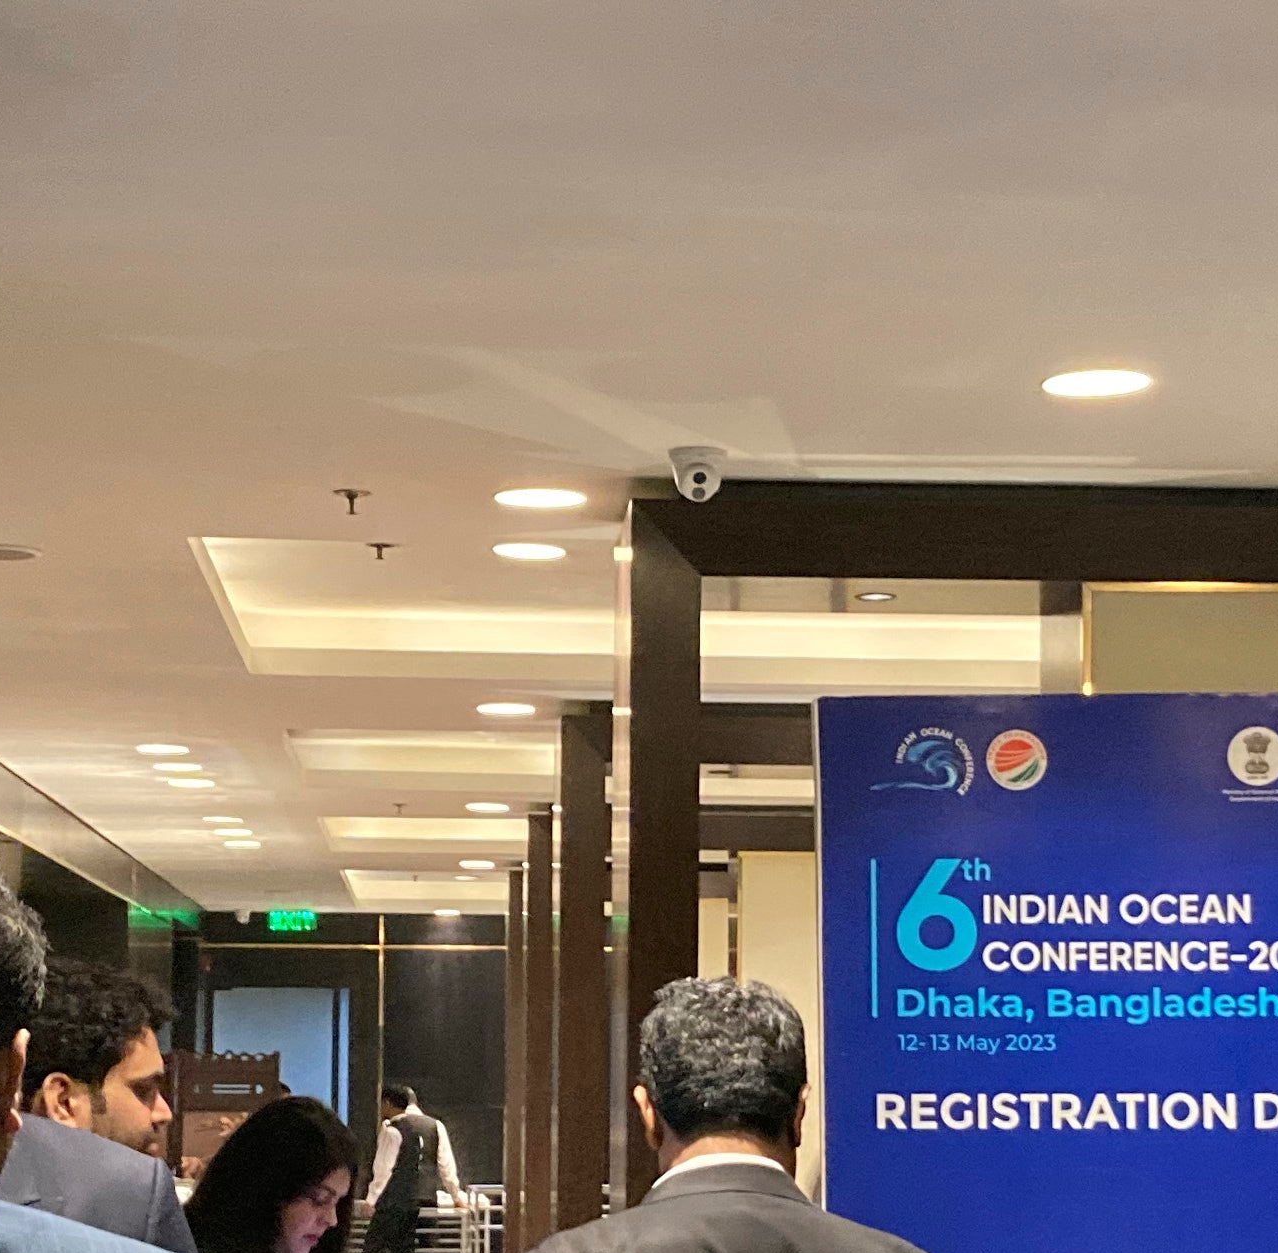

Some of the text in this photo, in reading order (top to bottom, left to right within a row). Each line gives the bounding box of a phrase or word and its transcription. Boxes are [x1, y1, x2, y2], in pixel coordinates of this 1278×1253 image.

[895, 732, 918, 764] INDIAN
[920, 726, 954, 740] OCEAN
[269, 910, 316, 931] EXIT
[982, 893, 1253, 925] INDIAN OCEAN
[897, 987, 1034, 1023] Dhaka,
[956, 1034, 1001, 1055] May
[1005, 1033, 1057, 1052] 2023
[876, 1092, 1238, 1130] REGISTRATION
